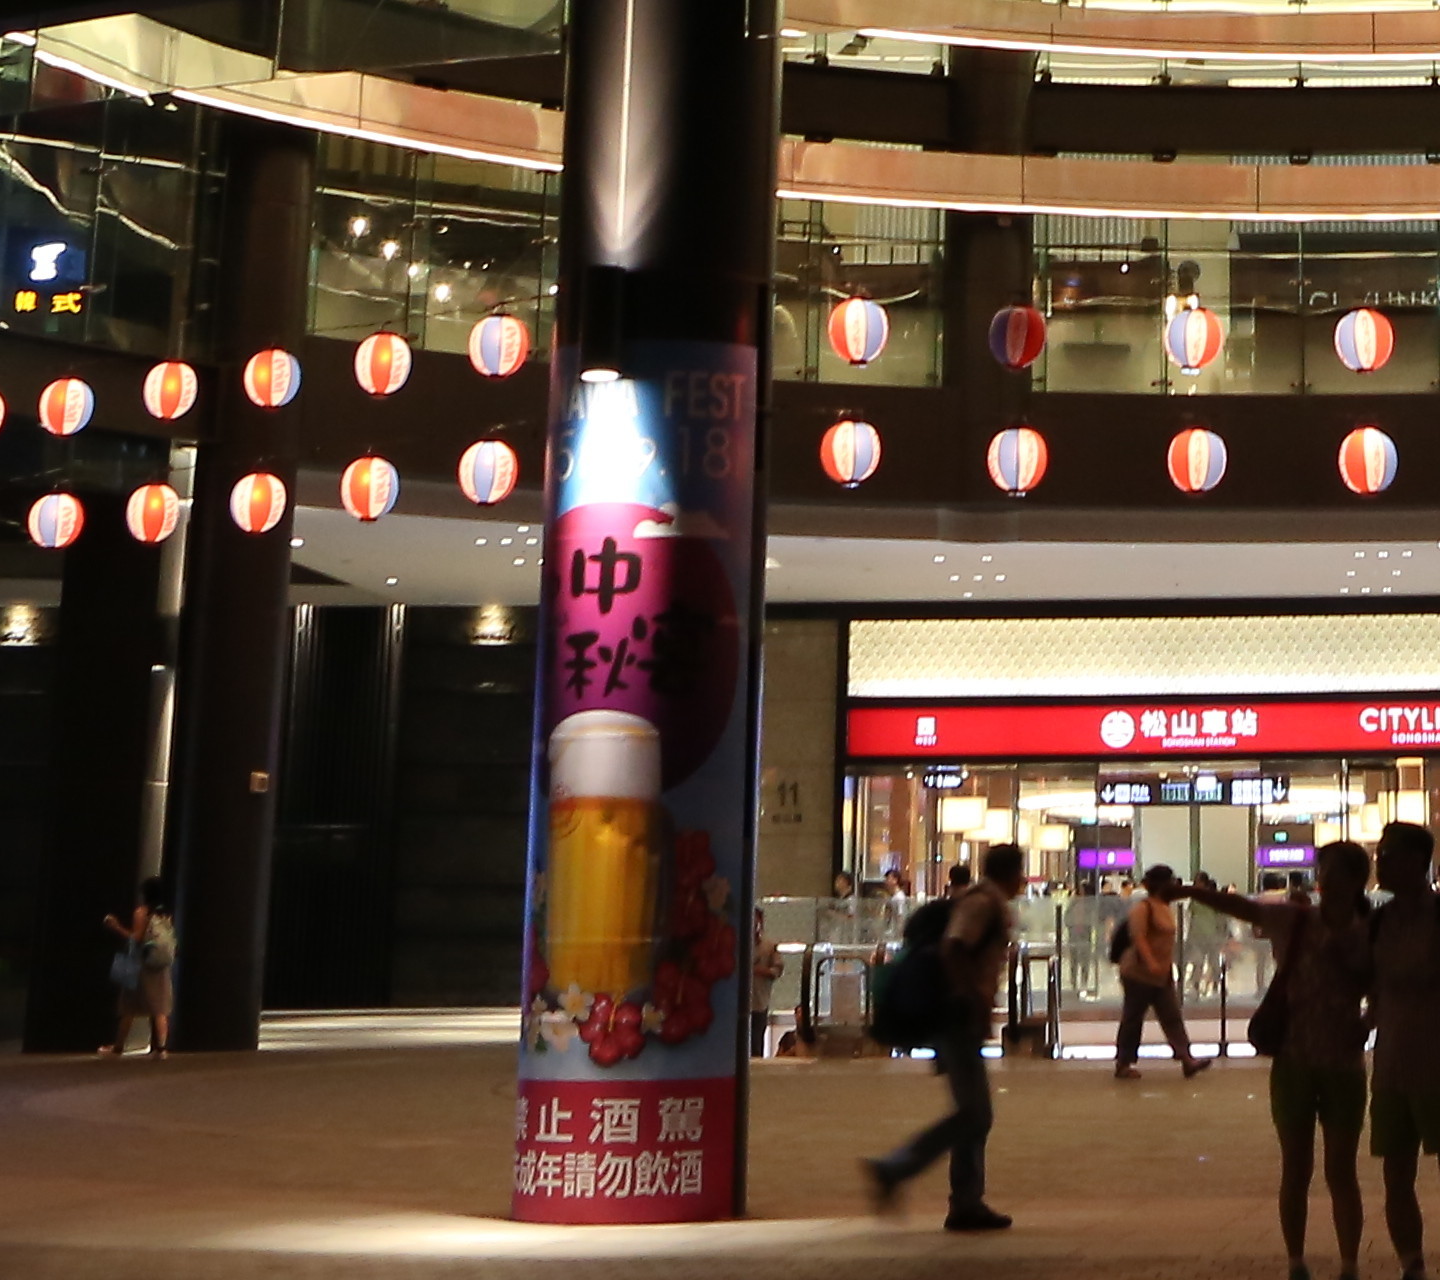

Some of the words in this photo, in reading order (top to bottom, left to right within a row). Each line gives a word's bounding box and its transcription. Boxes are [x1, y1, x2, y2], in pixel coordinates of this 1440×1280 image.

[663, 369, 746, 420] FEST
[1140, 708, 1259, 737] 松山車站
[513, 1149, 704, 1199] 成年請勿飲酒
